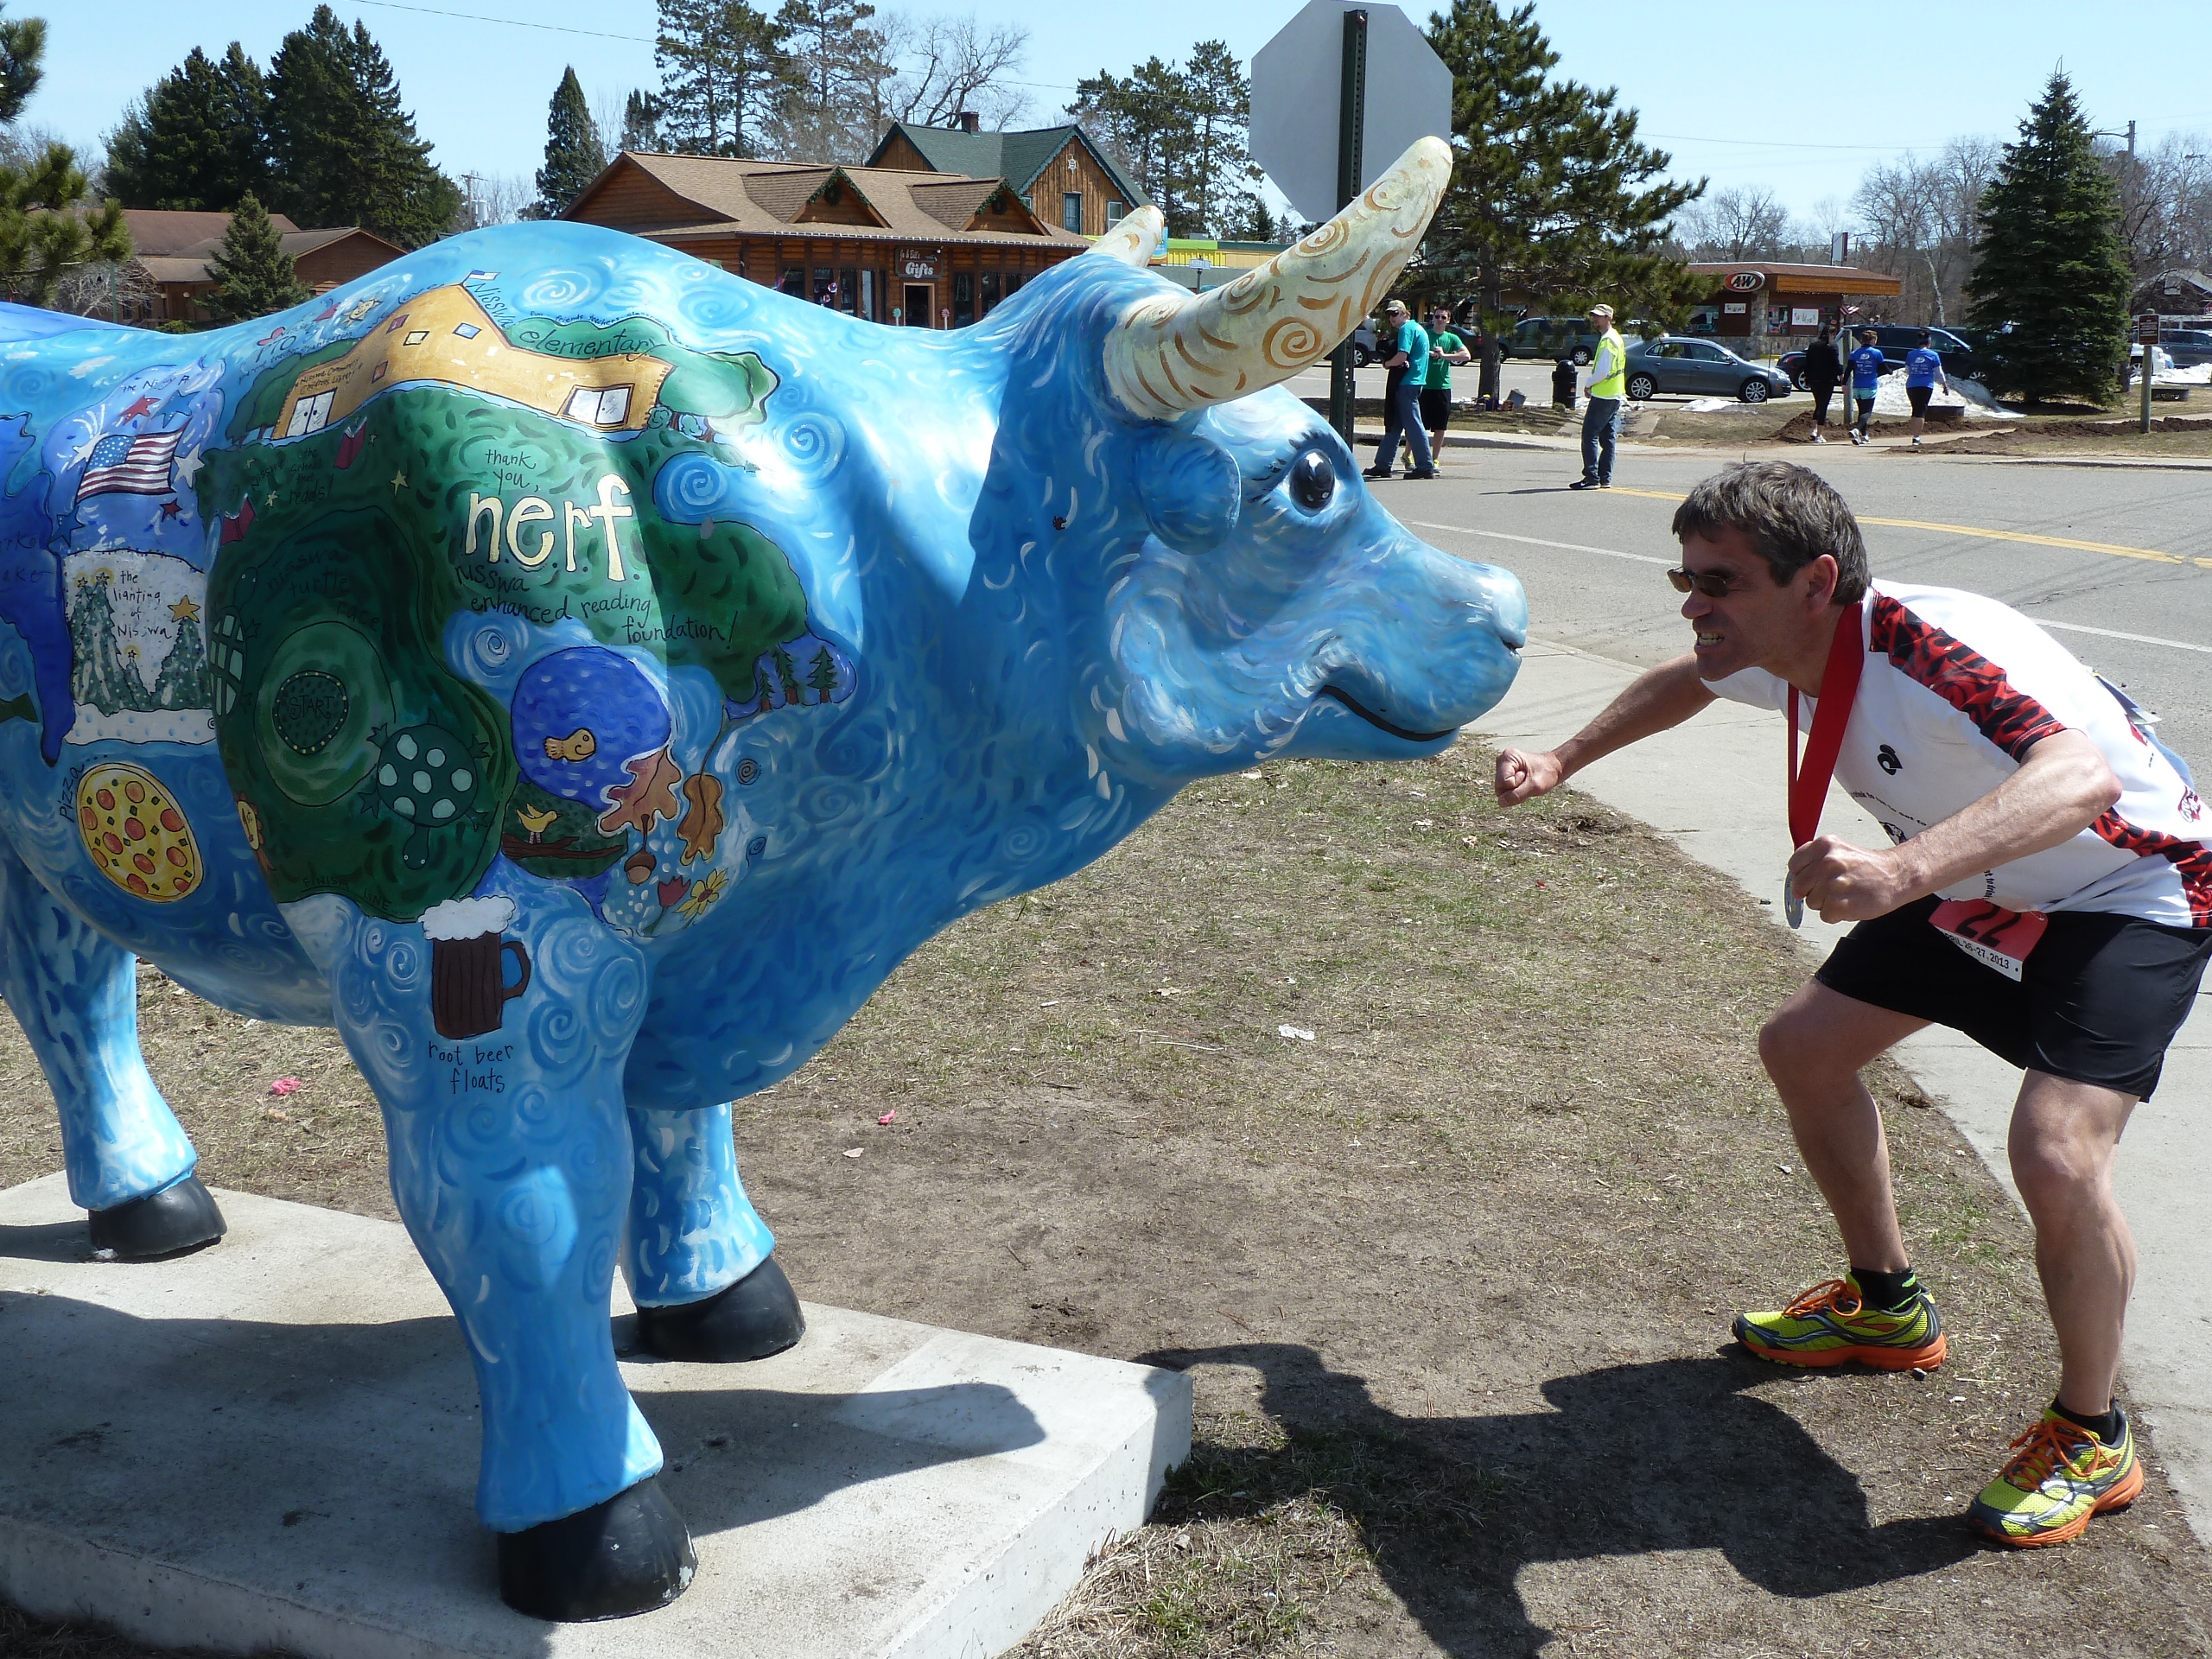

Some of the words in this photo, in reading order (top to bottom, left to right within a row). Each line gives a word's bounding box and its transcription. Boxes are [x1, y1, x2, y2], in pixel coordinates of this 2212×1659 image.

[905, 262, 934, 279] Gifts
[466, 282, 517, 328] Nisswa
[519, 328, 667, 362] elementary
[485, 448, 537, 470] thank
[120, 570, 138, 584] the
[471, 594, 574, 625] enhanced
[580, 588, 652, 628] reading
[1955, 905, 2023, 949] 22
[1942, 933, 1964, 947] PRIL
[1989, 952, 2010, 969] 2013
[429, 1040, 463, 1065] root
[475, 1045, 514, 1065] beer
[450, 1067, 505, 1095] floats
